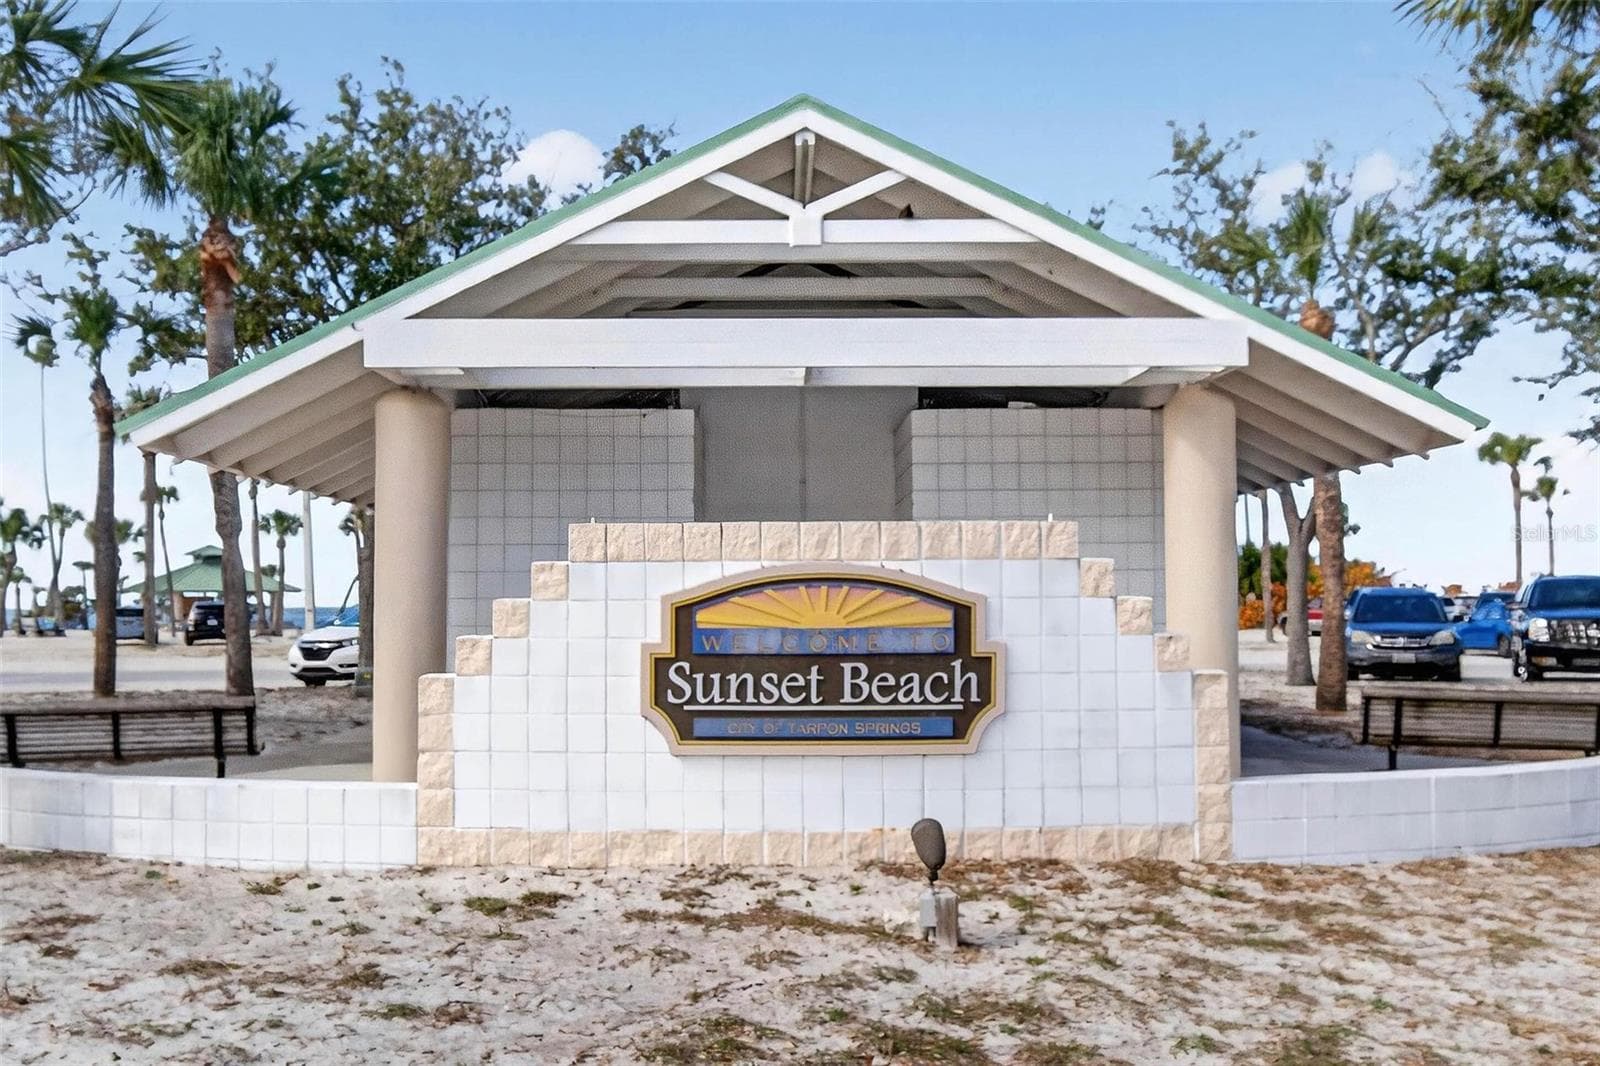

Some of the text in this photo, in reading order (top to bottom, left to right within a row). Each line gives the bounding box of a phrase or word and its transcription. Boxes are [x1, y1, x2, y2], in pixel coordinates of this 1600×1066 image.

[702, 633, 951, 652] WELCOME TO
[667, 659, 981, 704] Sunset Beach
[727, 721, 921, 736] CITY OF TARPON SPRINGS
